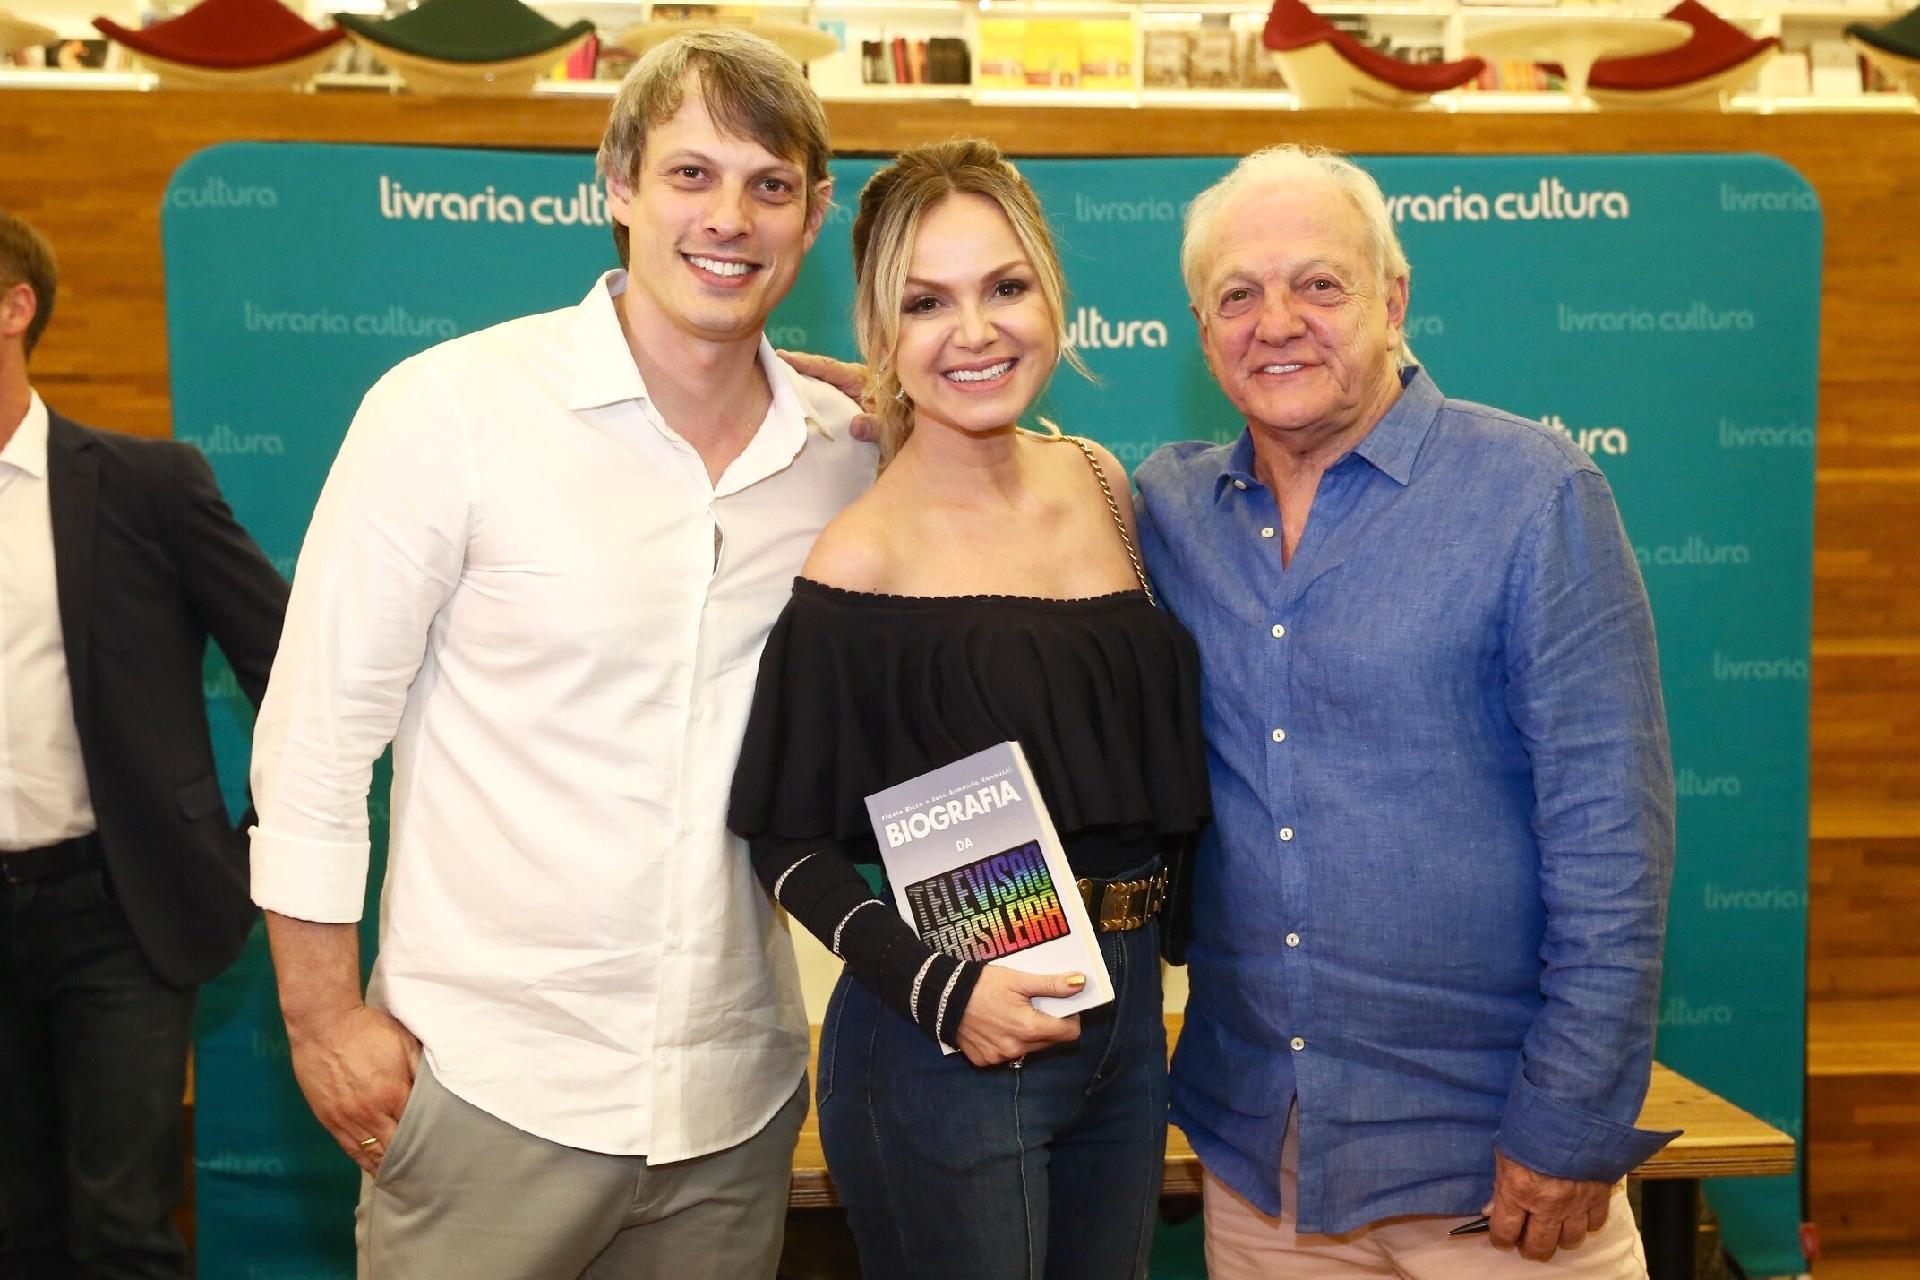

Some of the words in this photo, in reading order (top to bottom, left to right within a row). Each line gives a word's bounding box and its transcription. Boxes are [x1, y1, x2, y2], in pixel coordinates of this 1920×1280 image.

[170, 176, 279, 208] cultura
[379, 174, 526, 224] livraria
[529, 183, 613, 226] cult
[1075, 192, 1175, 222] livraria
[1494, 176, 1631, 220] cultura
[1721, 182, 1819, 211] livraria
[243, 300, 351, 335] livraria
[354, 304, 460, 339] cultura
[1557, 303, 1654, 333] livraria
[1658, 302, 1755, 331] cultura
[1718, 417, 1815, 448] livraria
[1653, 535, 1750, 565] cultura
[1712, 650, 1809, 681] livraria
[885, 780, 1021, 848] BIOGRAFIA
[955, 837, 974, 852] DA
[1704, 881, 1799, 910] livraria
